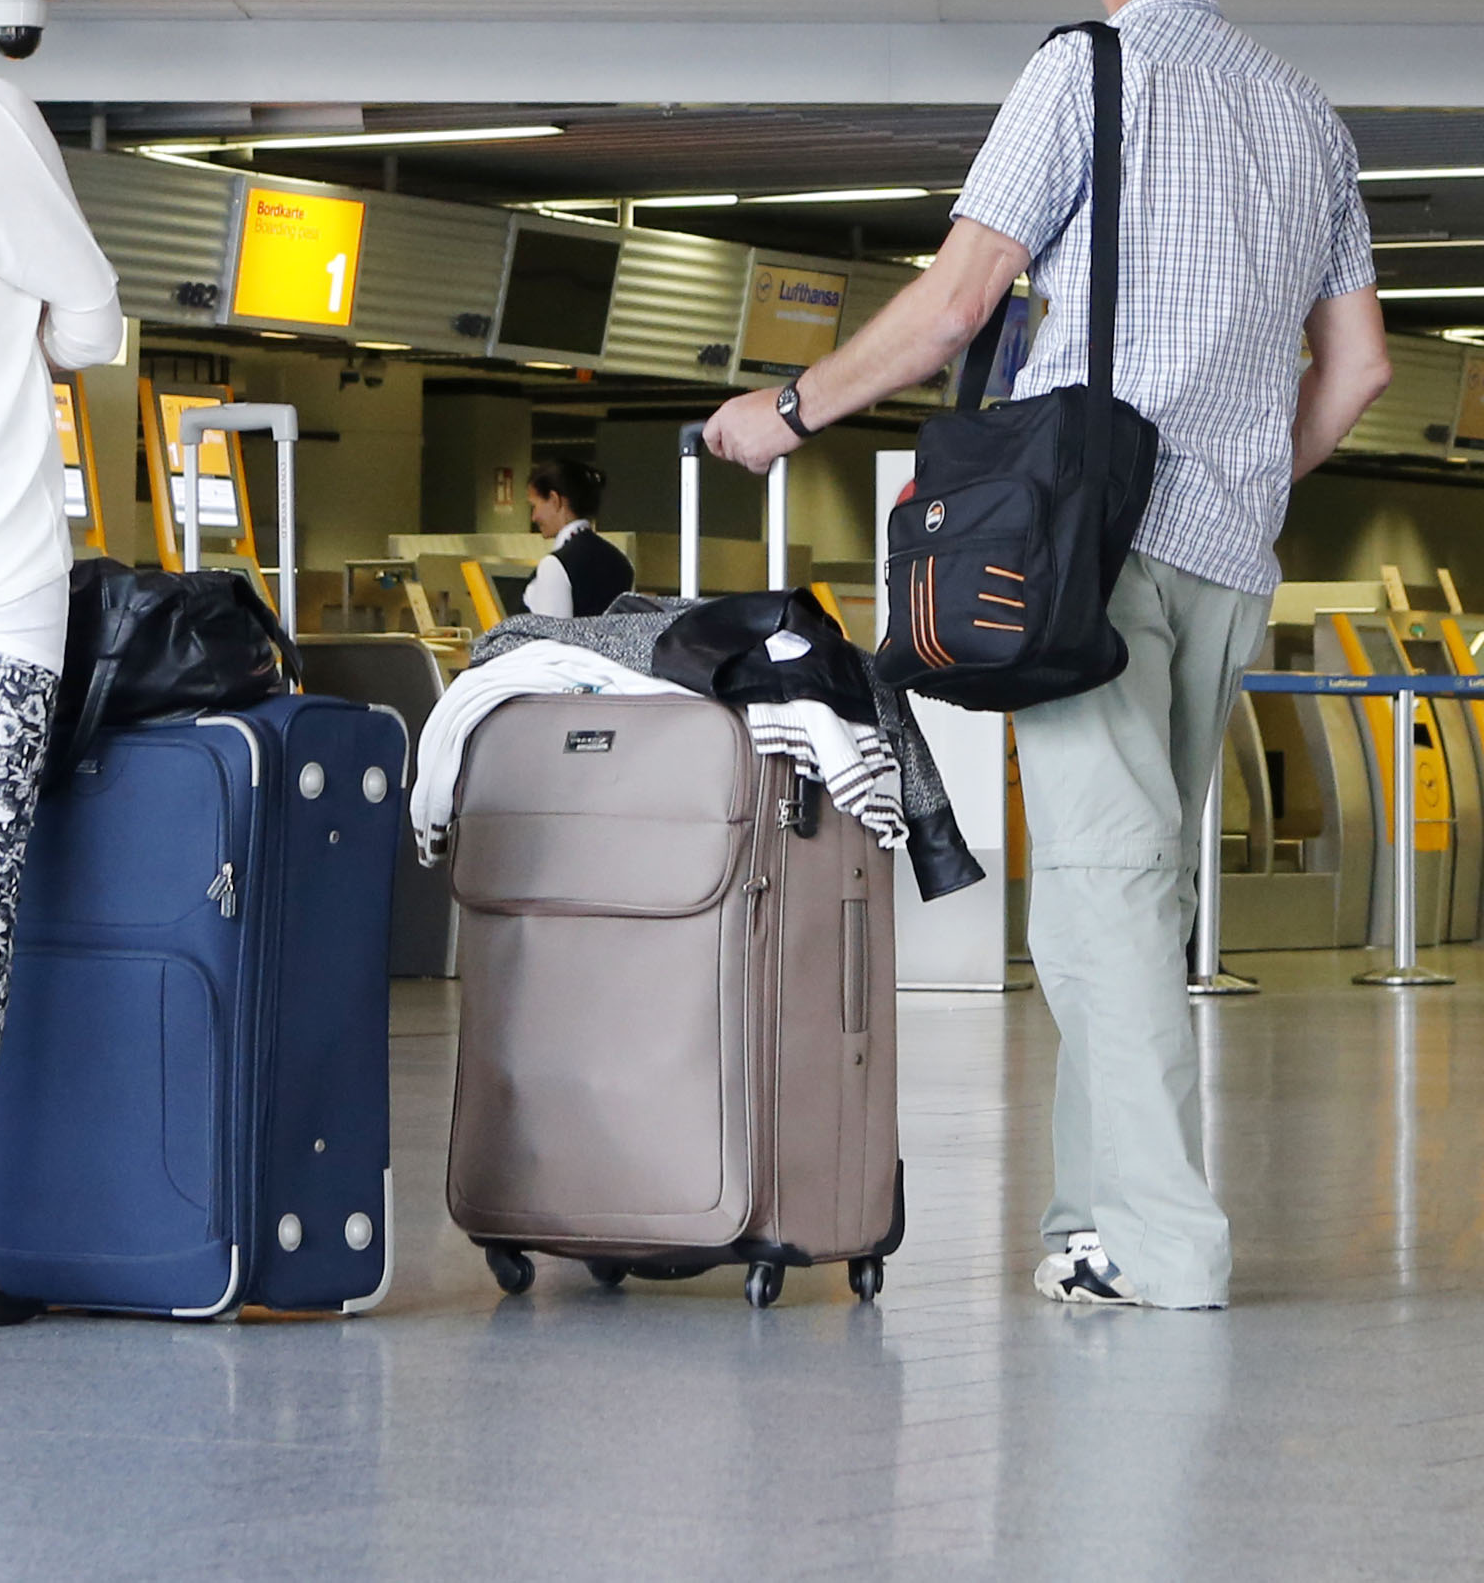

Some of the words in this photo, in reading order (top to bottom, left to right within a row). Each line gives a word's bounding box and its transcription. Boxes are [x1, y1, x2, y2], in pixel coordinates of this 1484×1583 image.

[258, 201, 304, 220] Bordkarte
[327, 254, 346, 312] 1
[779, 280, 840, 307] Lufthansa
